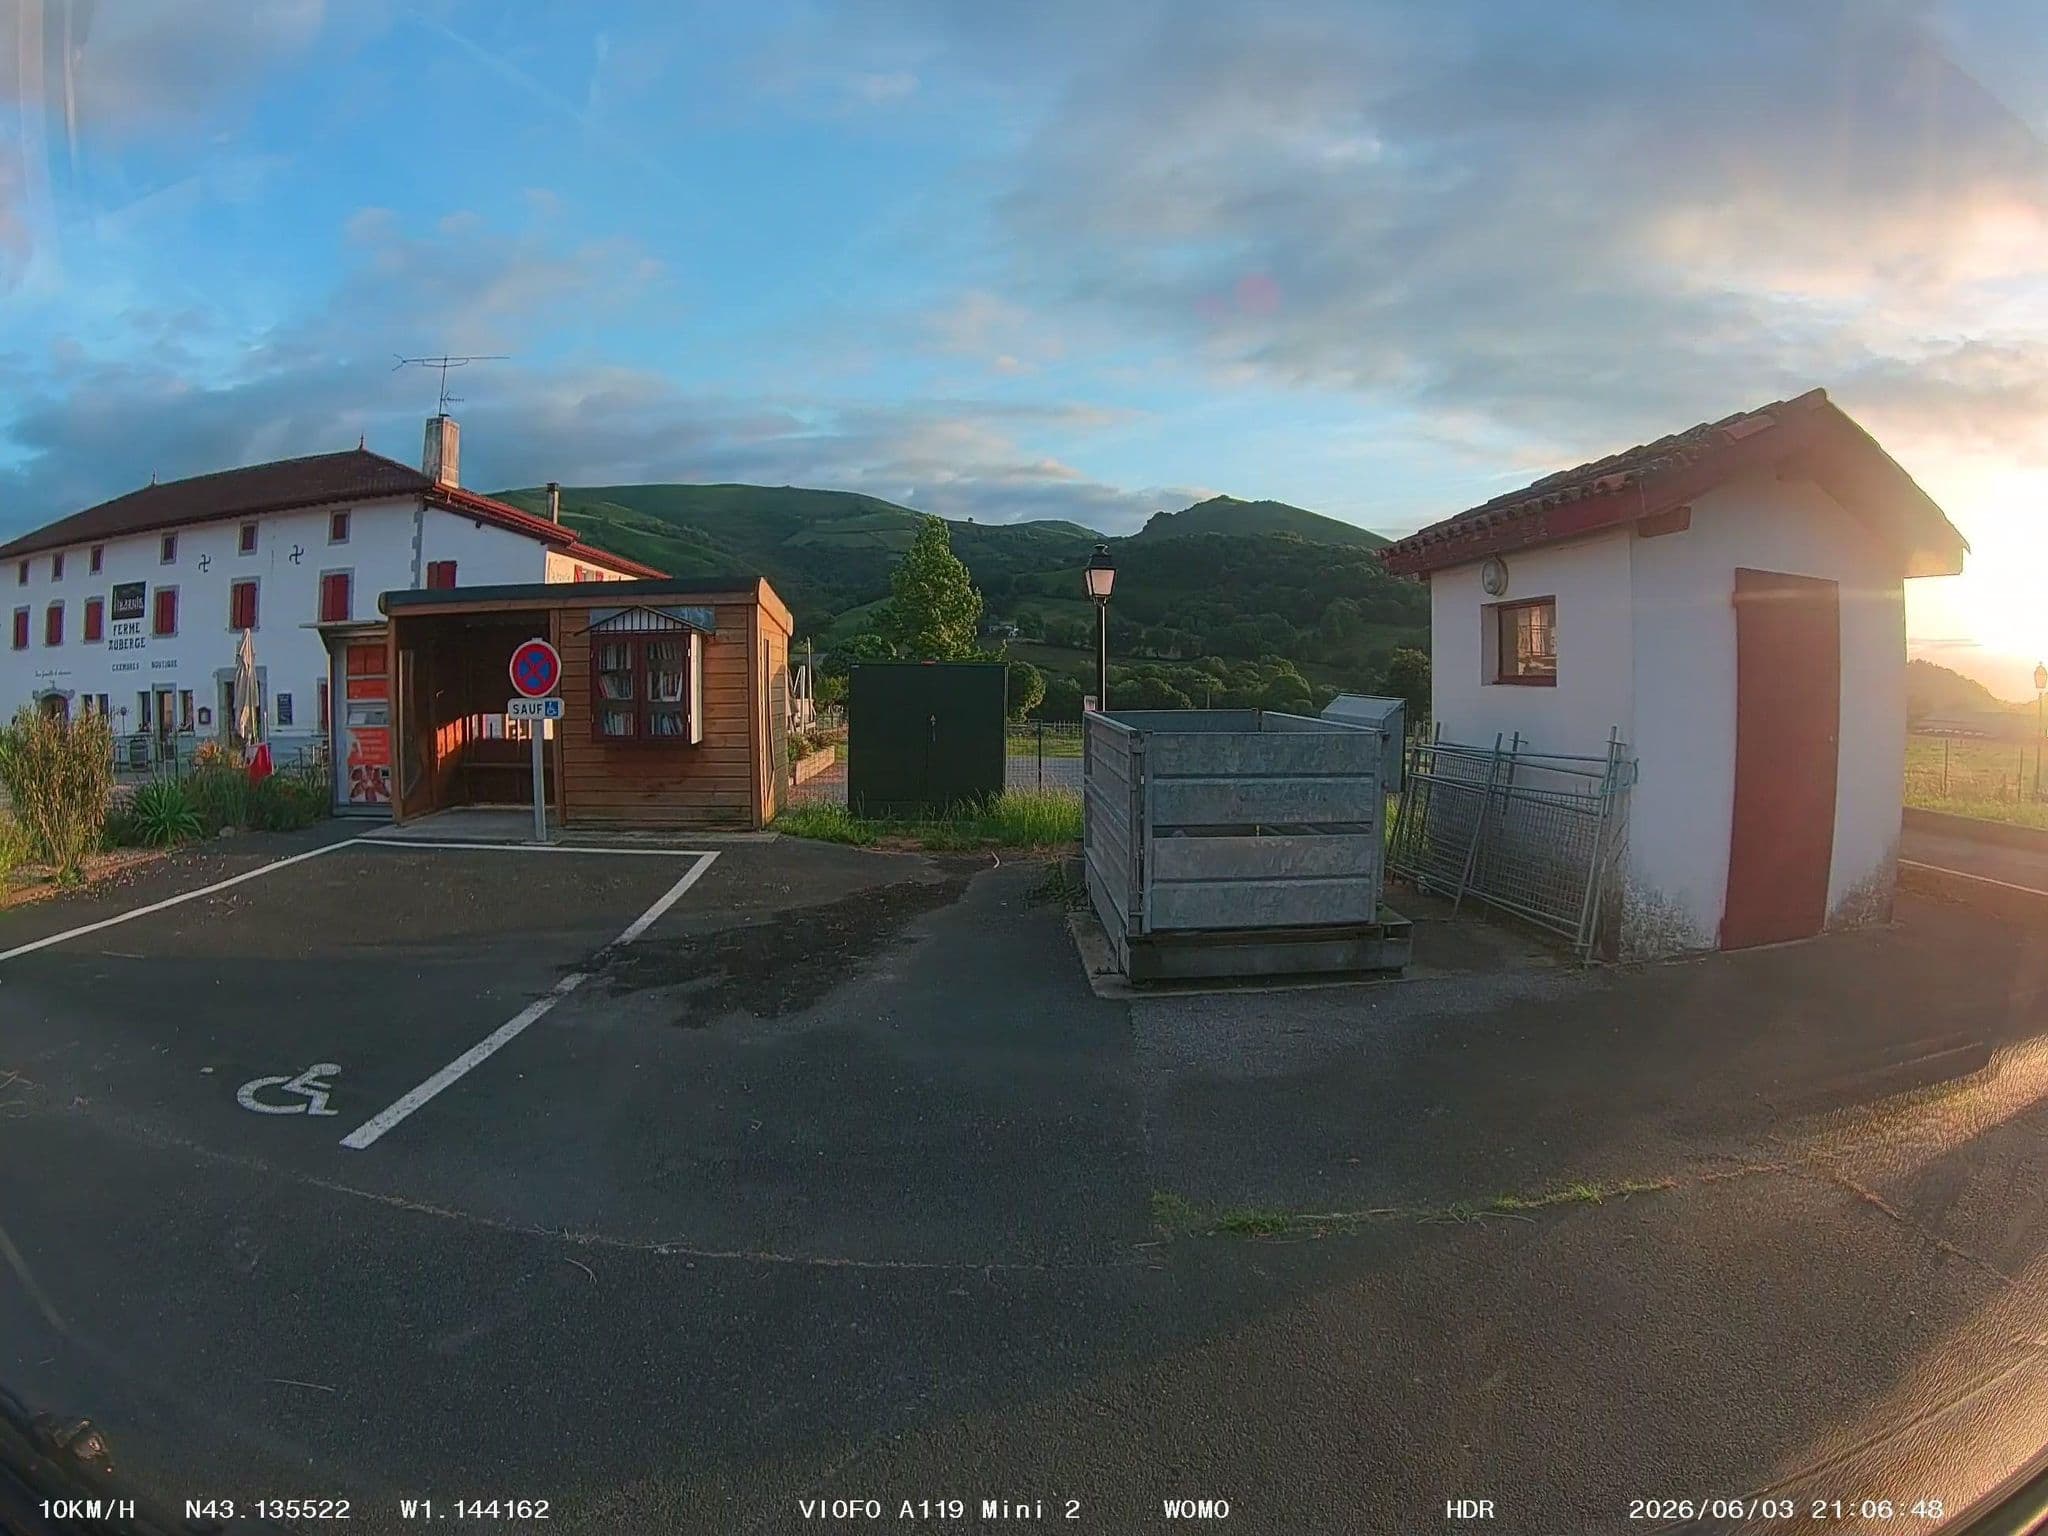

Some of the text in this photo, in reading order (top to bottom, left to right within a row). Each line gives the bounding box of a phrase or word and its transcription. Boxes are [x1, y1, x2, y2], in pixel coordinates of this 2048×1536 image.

[113, 622, 141, 637] FERME
[108, 637, 146, 651] AUBERGE
[513, 703, 543, 715] SAUF
